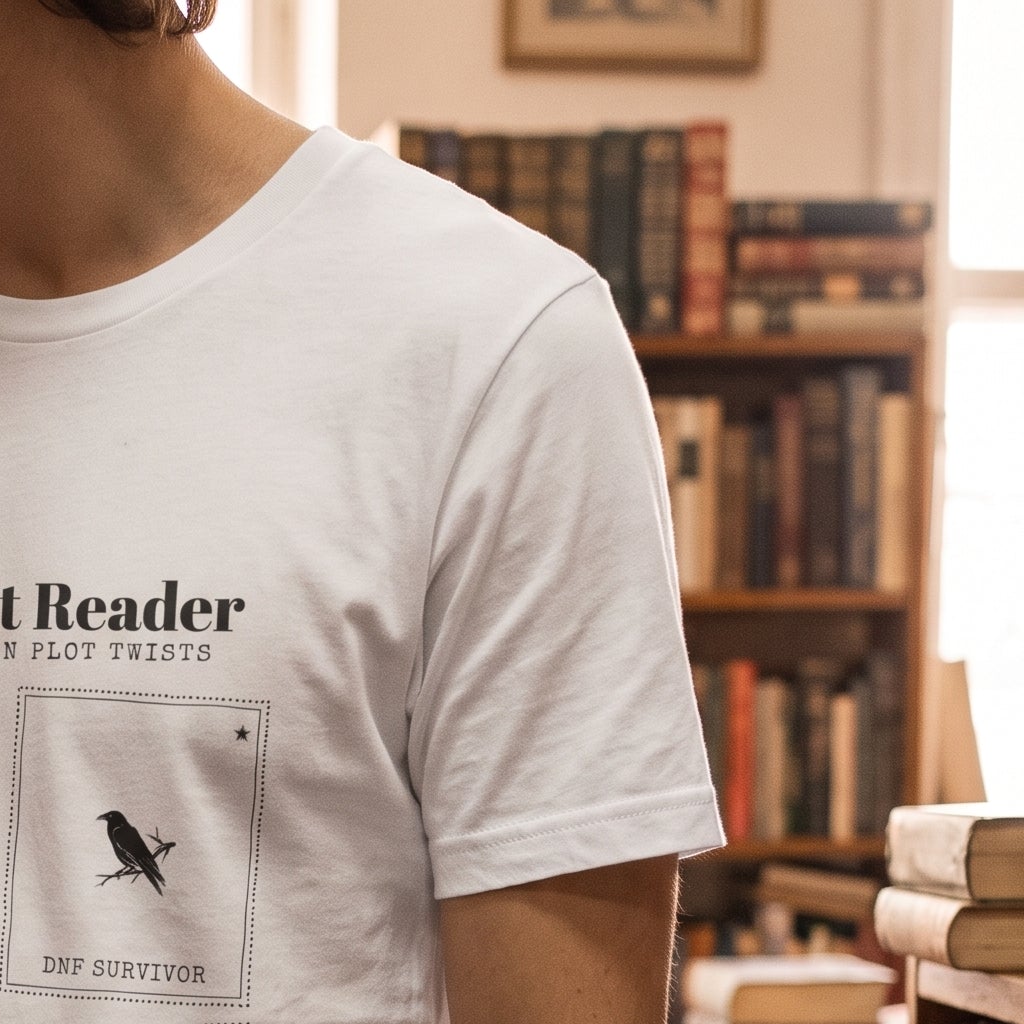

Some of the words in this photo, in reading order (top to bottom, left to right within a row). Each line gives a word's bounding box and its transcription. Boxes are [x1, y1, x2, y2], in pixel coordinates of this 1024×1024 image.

[32, 580, 246, 632] Reader
[31, 641, 96, 660] PLOT
[109, 643, 212, 662] TWISTS
[42, 956, 85, 975] DNF
[92, 959, 206, 983] SURVIVOR
